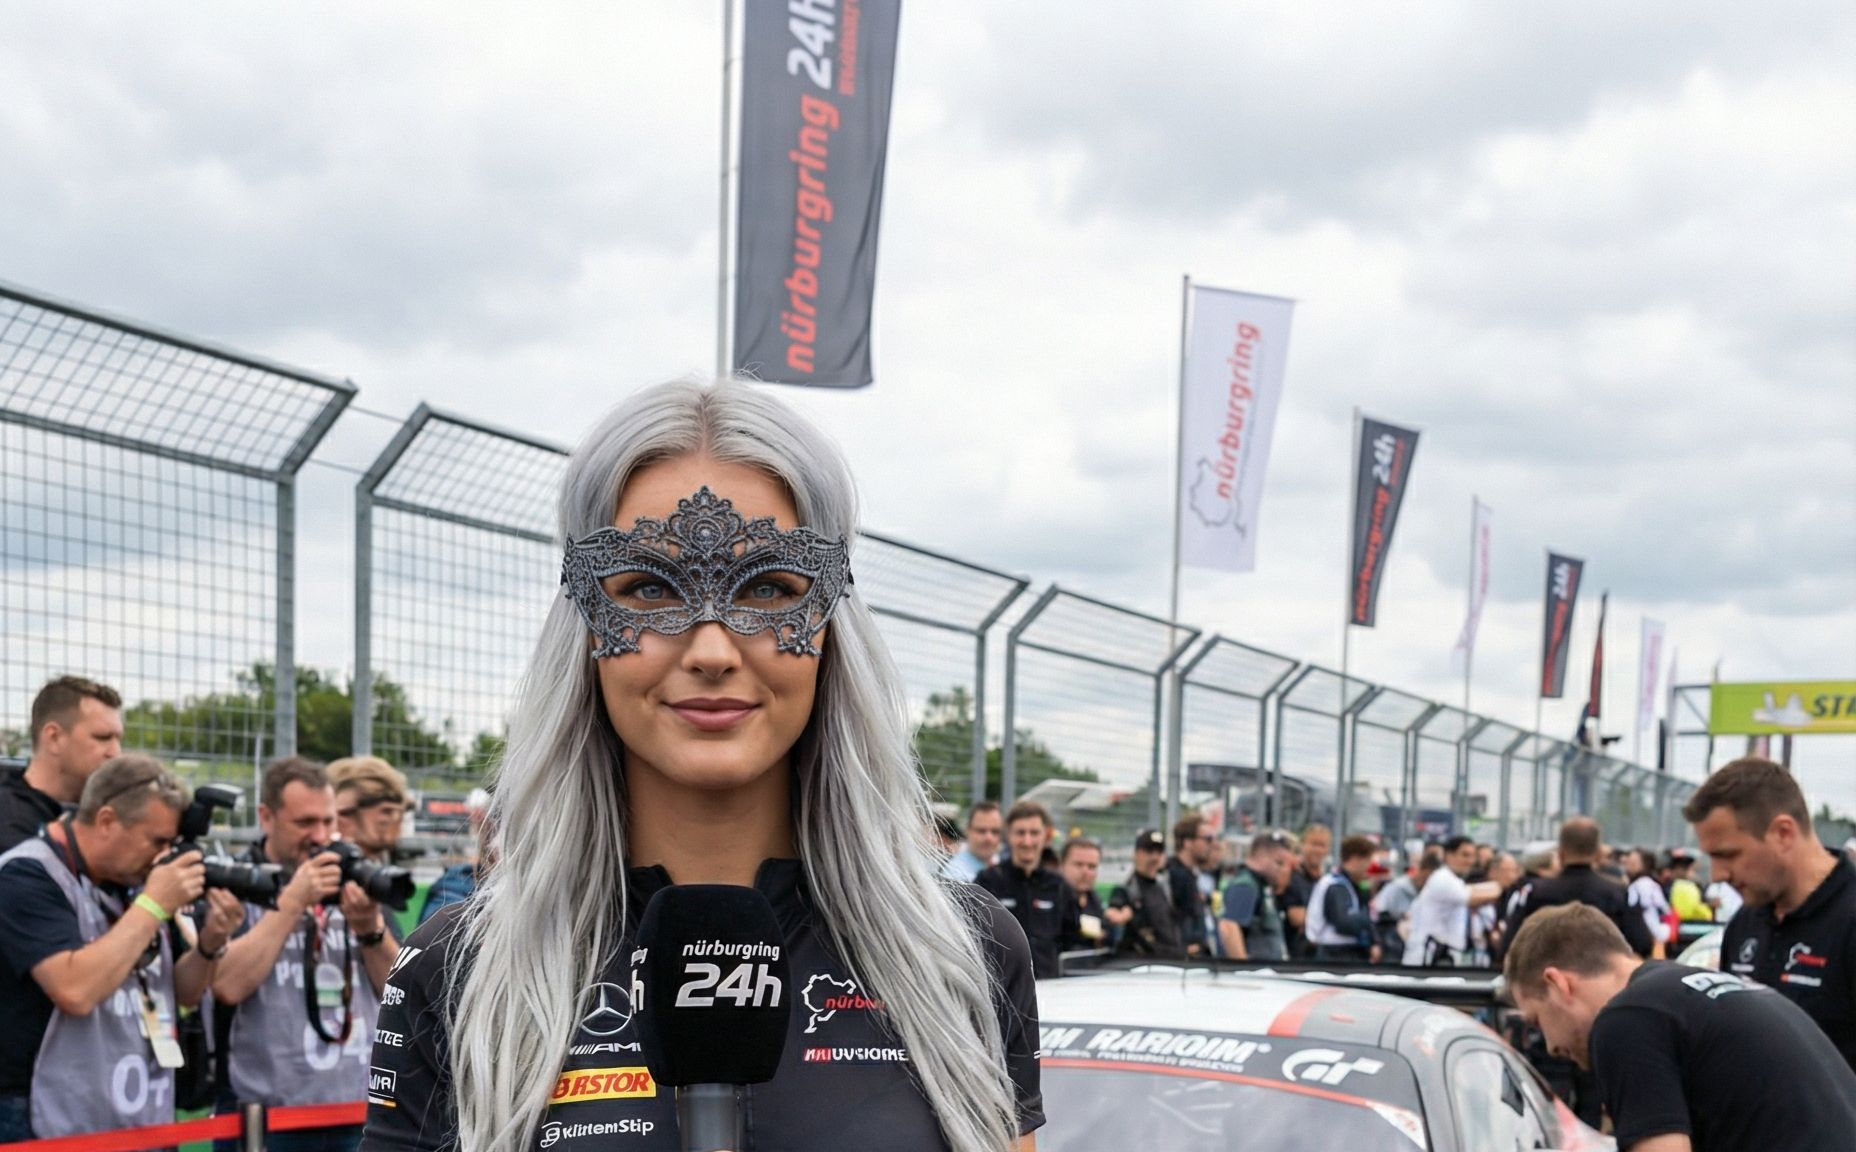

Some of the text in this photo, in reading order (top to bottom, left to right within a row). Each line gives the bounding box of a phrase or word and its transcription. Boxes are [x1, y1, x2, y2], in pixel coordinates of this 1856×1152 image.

[780, 94, 840, 374] nürburgring
[1213, 321, 1262, 500] nürburgring
[675, 963, 782, 1008] 24h
[682, 940, 780, 962] nürburgring
